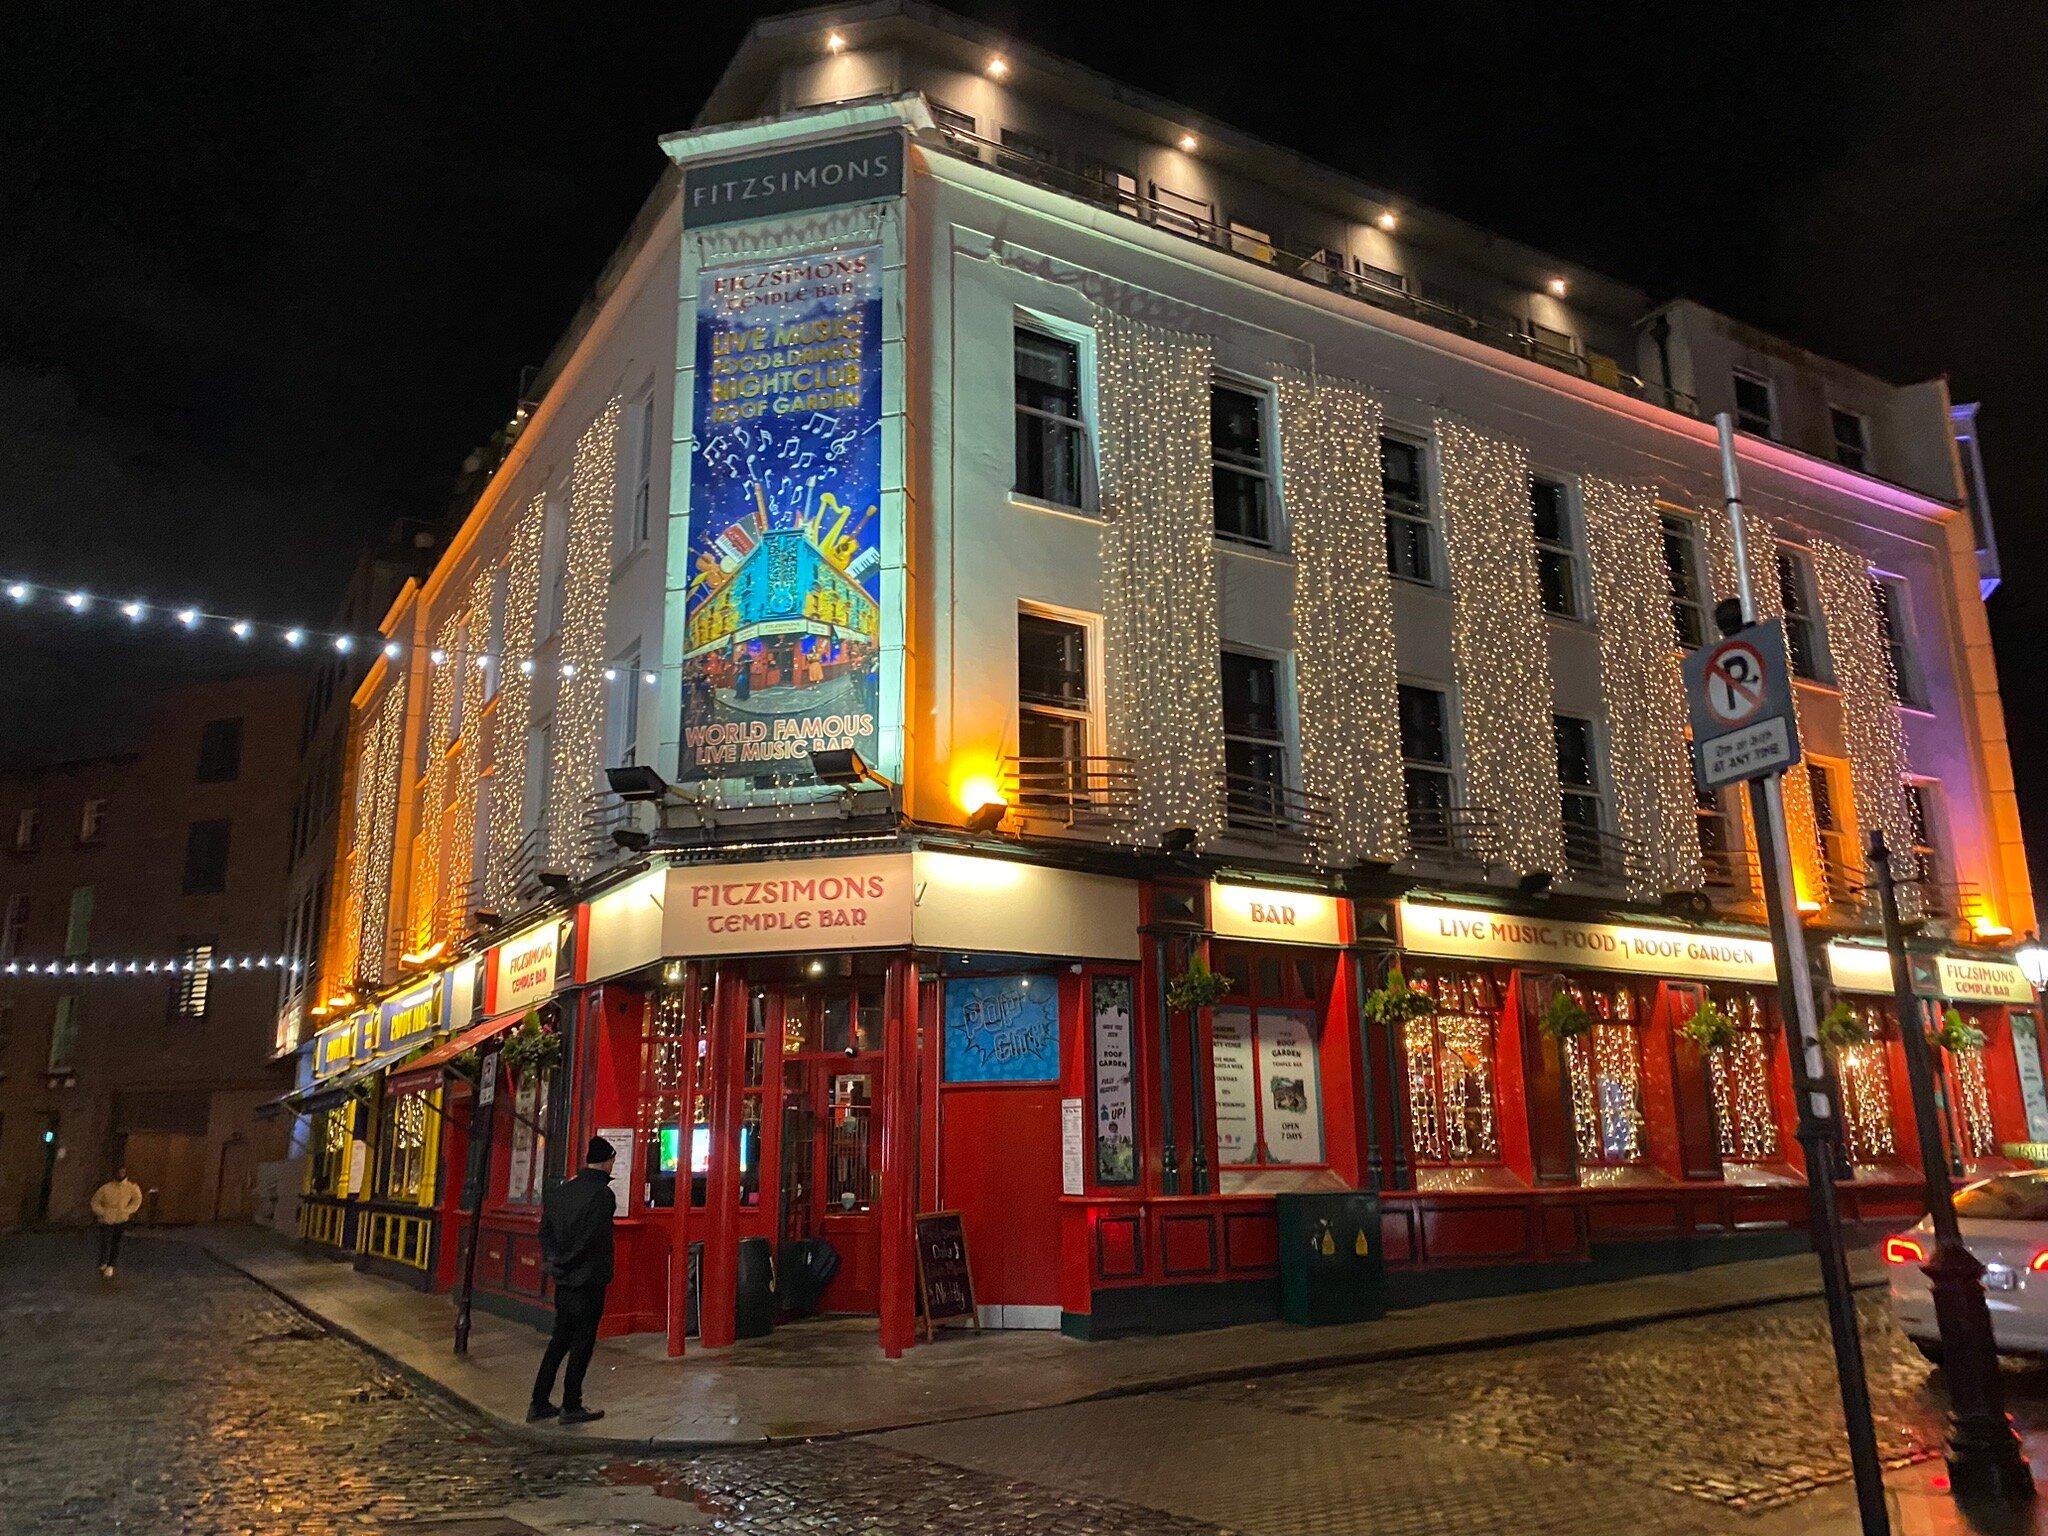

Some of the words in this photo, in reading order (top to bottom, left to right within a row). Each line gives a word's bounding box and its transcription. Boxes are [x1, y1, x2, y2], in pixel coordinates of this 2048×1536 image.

[693, 155, 890, 208] FITZSIMONS
[714, 257, 868, 294] FITZSIMONS
[727, 290, 809, 311] TEMPLE
[816, 283, 854, 298] BAR
[712, 327, 767, 356] LIVE
[774, 314, 862, 347] MUSIC
[711, 364, 861, 403] NIGHTCLUB
[712, 400, 768, 422] ROOF
[772, 392, 861, 415] GARDEN
[685, 721, 767, 748] WORLD
[773, 714, 874, 741] FAMOUS
[696, 745, 736, 766] LIVE
[740, 740, 809, 763] MUSIC
[691, 876, 884, 907] FITZSIMONS
[707, 911, 813, 934] TEMPLE
[818, 908, 868, 928] BAR
[1250, 902, 1296, 926] BAR
[1439, 918, 1485, 940] LIVE
[1490, 923, 1558, 950] MUSIC,
[1563, 929, 1617, 952] FOOD
[1634, 938, 1682, 958] ROOF
[1688, 943, 1754, 965] GARDEN
[1947, 964, 2015, 984] FITZSIMONS
[1955, 981, 1992, 996] TEMPLE
[1993, 985, 2010, 997] BAR
[1099, 1060, 1127, 1068] GARDEN
[1272, 1049, 1301, 1058] GARDEN
[1111, 1107, 1127, 1120] UP!
[1281, 1122, 1300, 1131] OPEN
